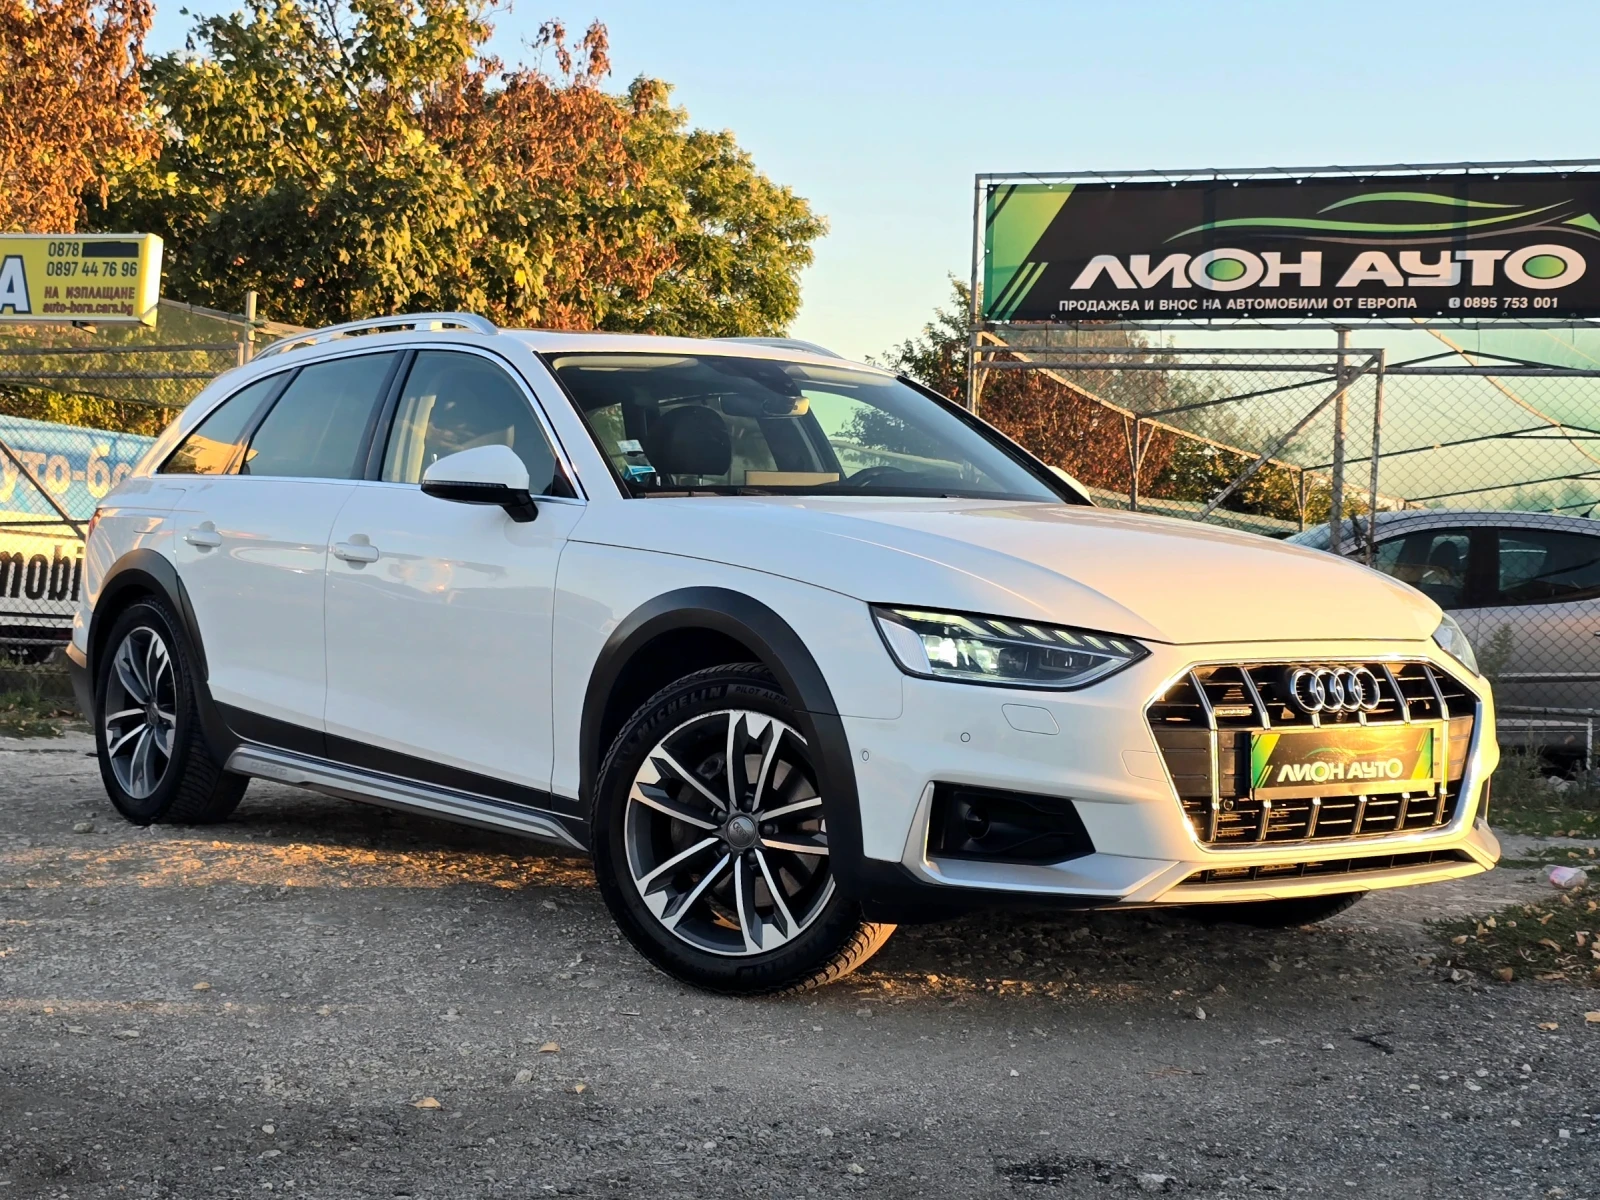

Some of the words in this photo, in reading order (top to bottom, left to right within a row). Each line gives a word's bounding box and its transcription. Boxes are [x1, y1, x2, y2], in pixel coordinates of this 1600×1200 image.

[48, 242, 80, 257] 0878
[46, 261, 79, 277] 0897
[81, 262, 98, 277] 44
[102, 262, 117, 276] 76
[121, 262, 138, 277] 96
[1070, 248, 1322, 291] ЛИОН
[1335, 244, 1587, 289] АУТО
[44, 286, 59, 299] НА
[65, 286, 136, 301] ИЗПЛАЩАНЕ
[1059, 299, 1139, 312] ПРОДАЖБА
[1144, 299, 1154, 311] И
[1159, 298, 1198, 311] ВНОС
[1202, 298, 1222, 310] НА
[1226, 297, 1328, 310] АВТОМОБИЛИ
[1332, 297, 1353, 309] ОТ
[1357, 296, 1418, 309] ЕВРОПА
[1463, 296, 1498, 309] 0895
[1502, 296, 1529, 309] 753
[1533, 296, 1558, 309] 001
[1276, 761, 1344, 782] ЛИОН
[1346, 758, 1403, 778] АУТО
